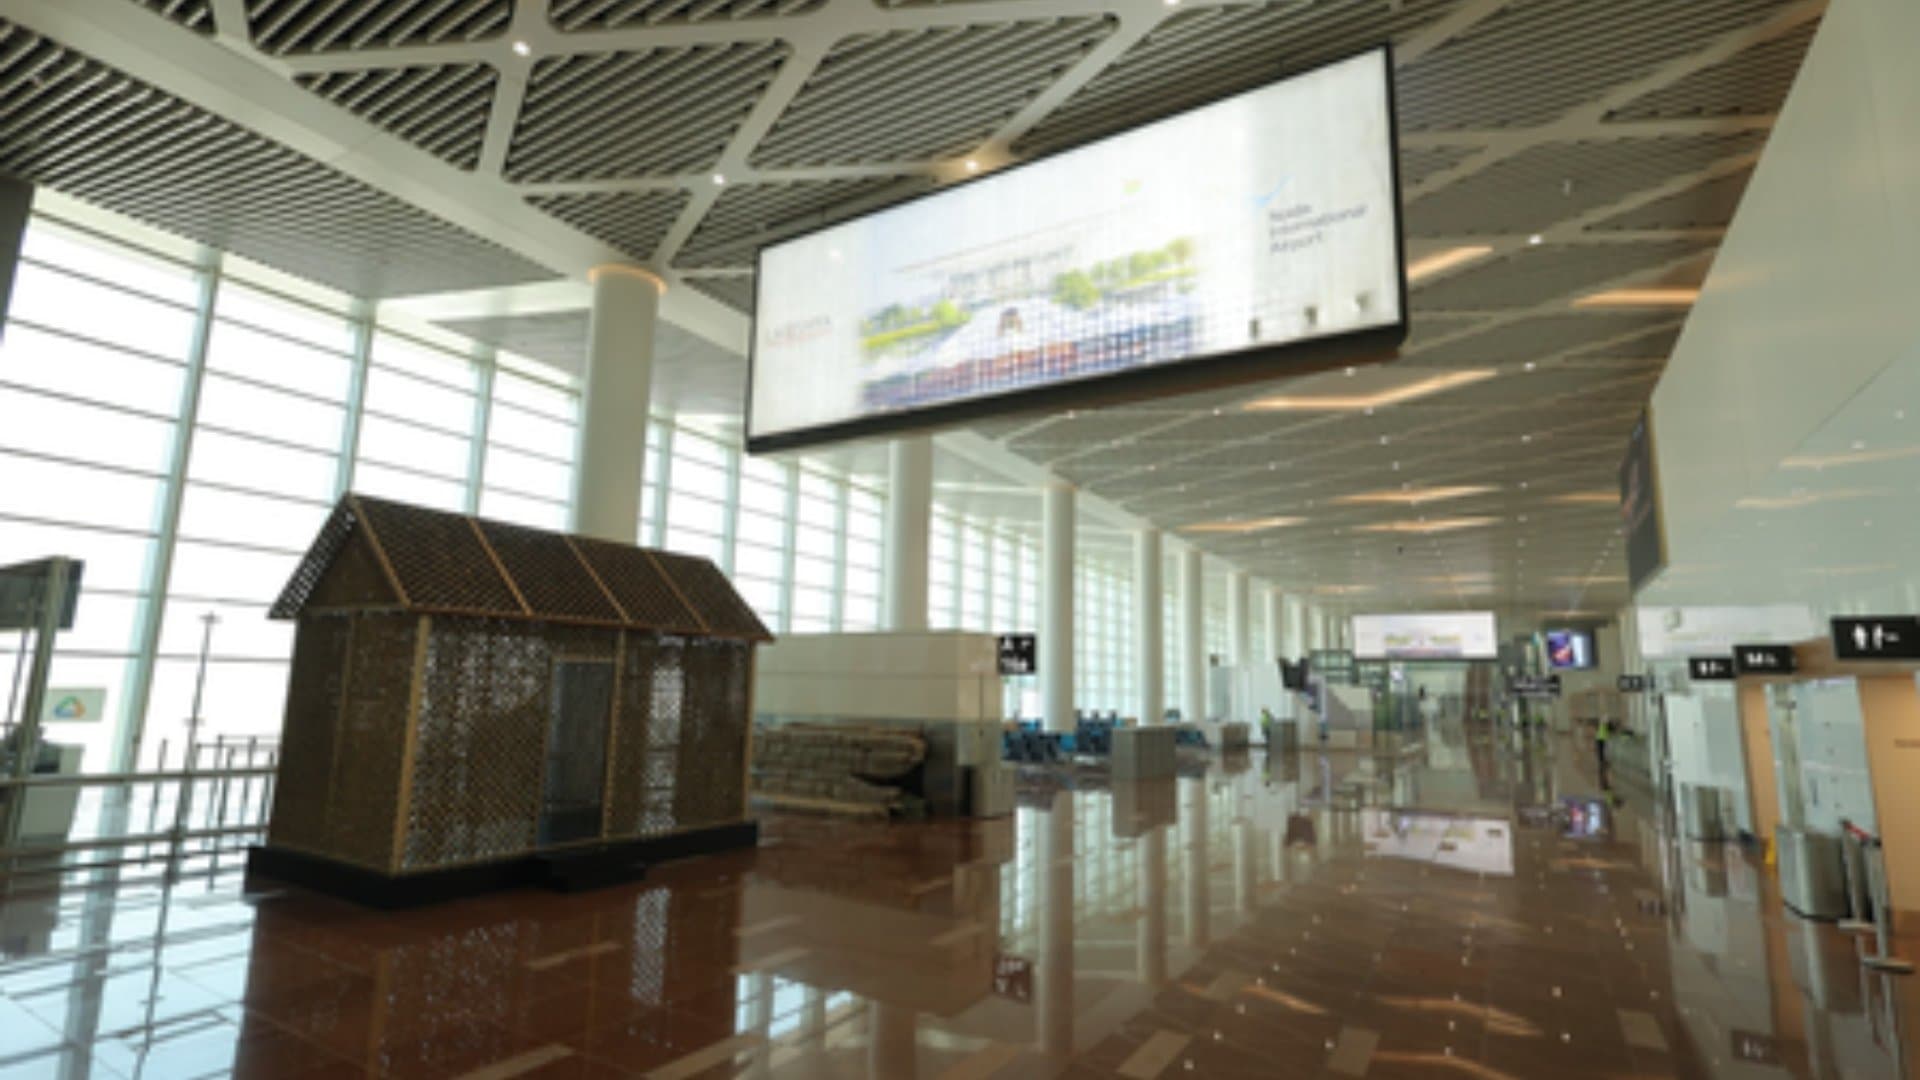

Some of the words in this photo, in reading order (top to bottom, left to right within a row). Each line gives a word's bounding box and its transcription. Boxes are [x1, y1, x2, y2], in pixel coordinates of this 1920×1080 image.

[1269, 204, 1312, 221] Noida
[1269, 203, 1368, 239] International
[1269, 230, 1323, 254] Airport
